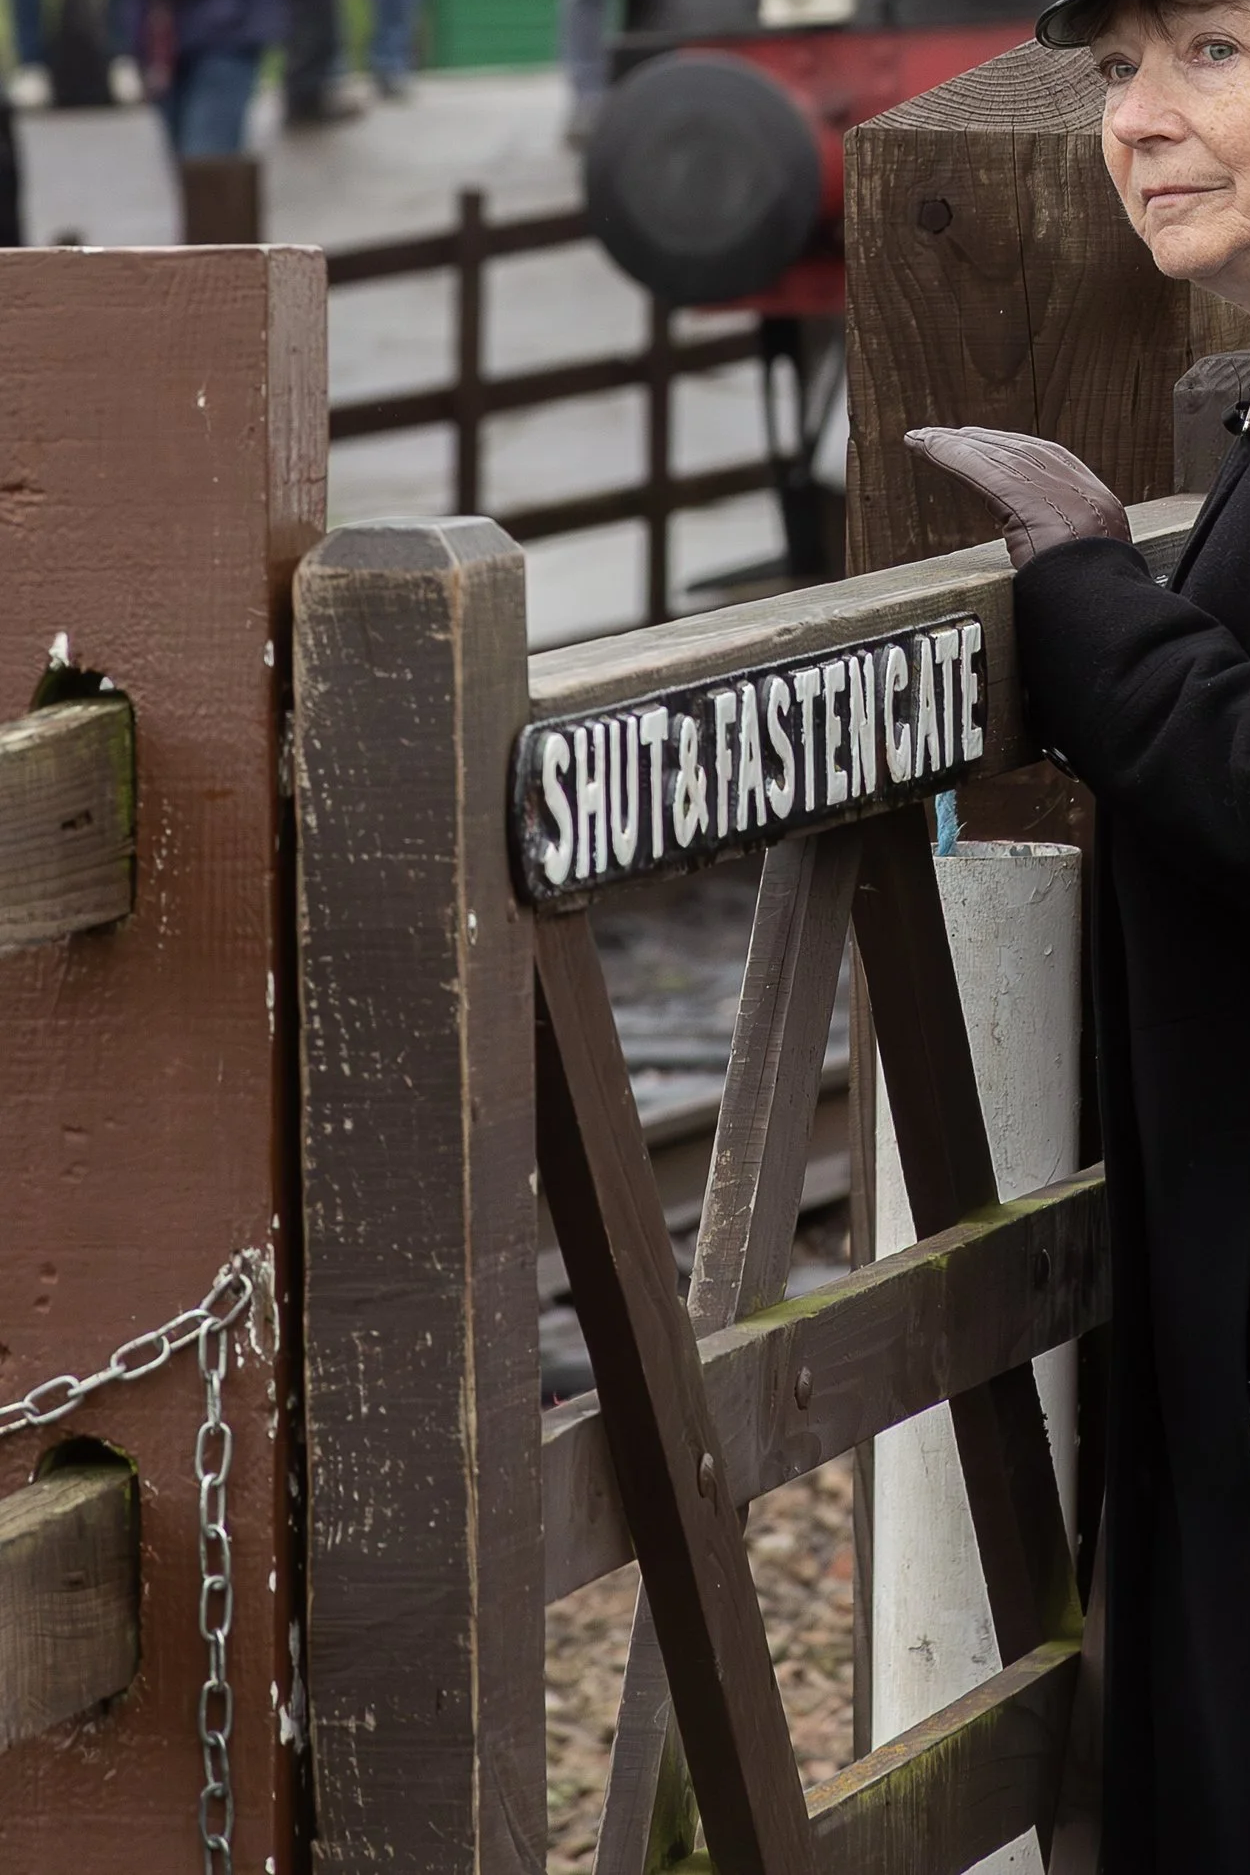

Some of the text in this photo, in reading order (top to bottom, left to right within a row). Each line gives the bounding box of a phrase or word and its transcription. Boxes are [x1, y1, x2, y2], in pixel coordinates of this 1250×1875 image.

[542, 621, 984, 886] SHUT & FASTEN GATE
